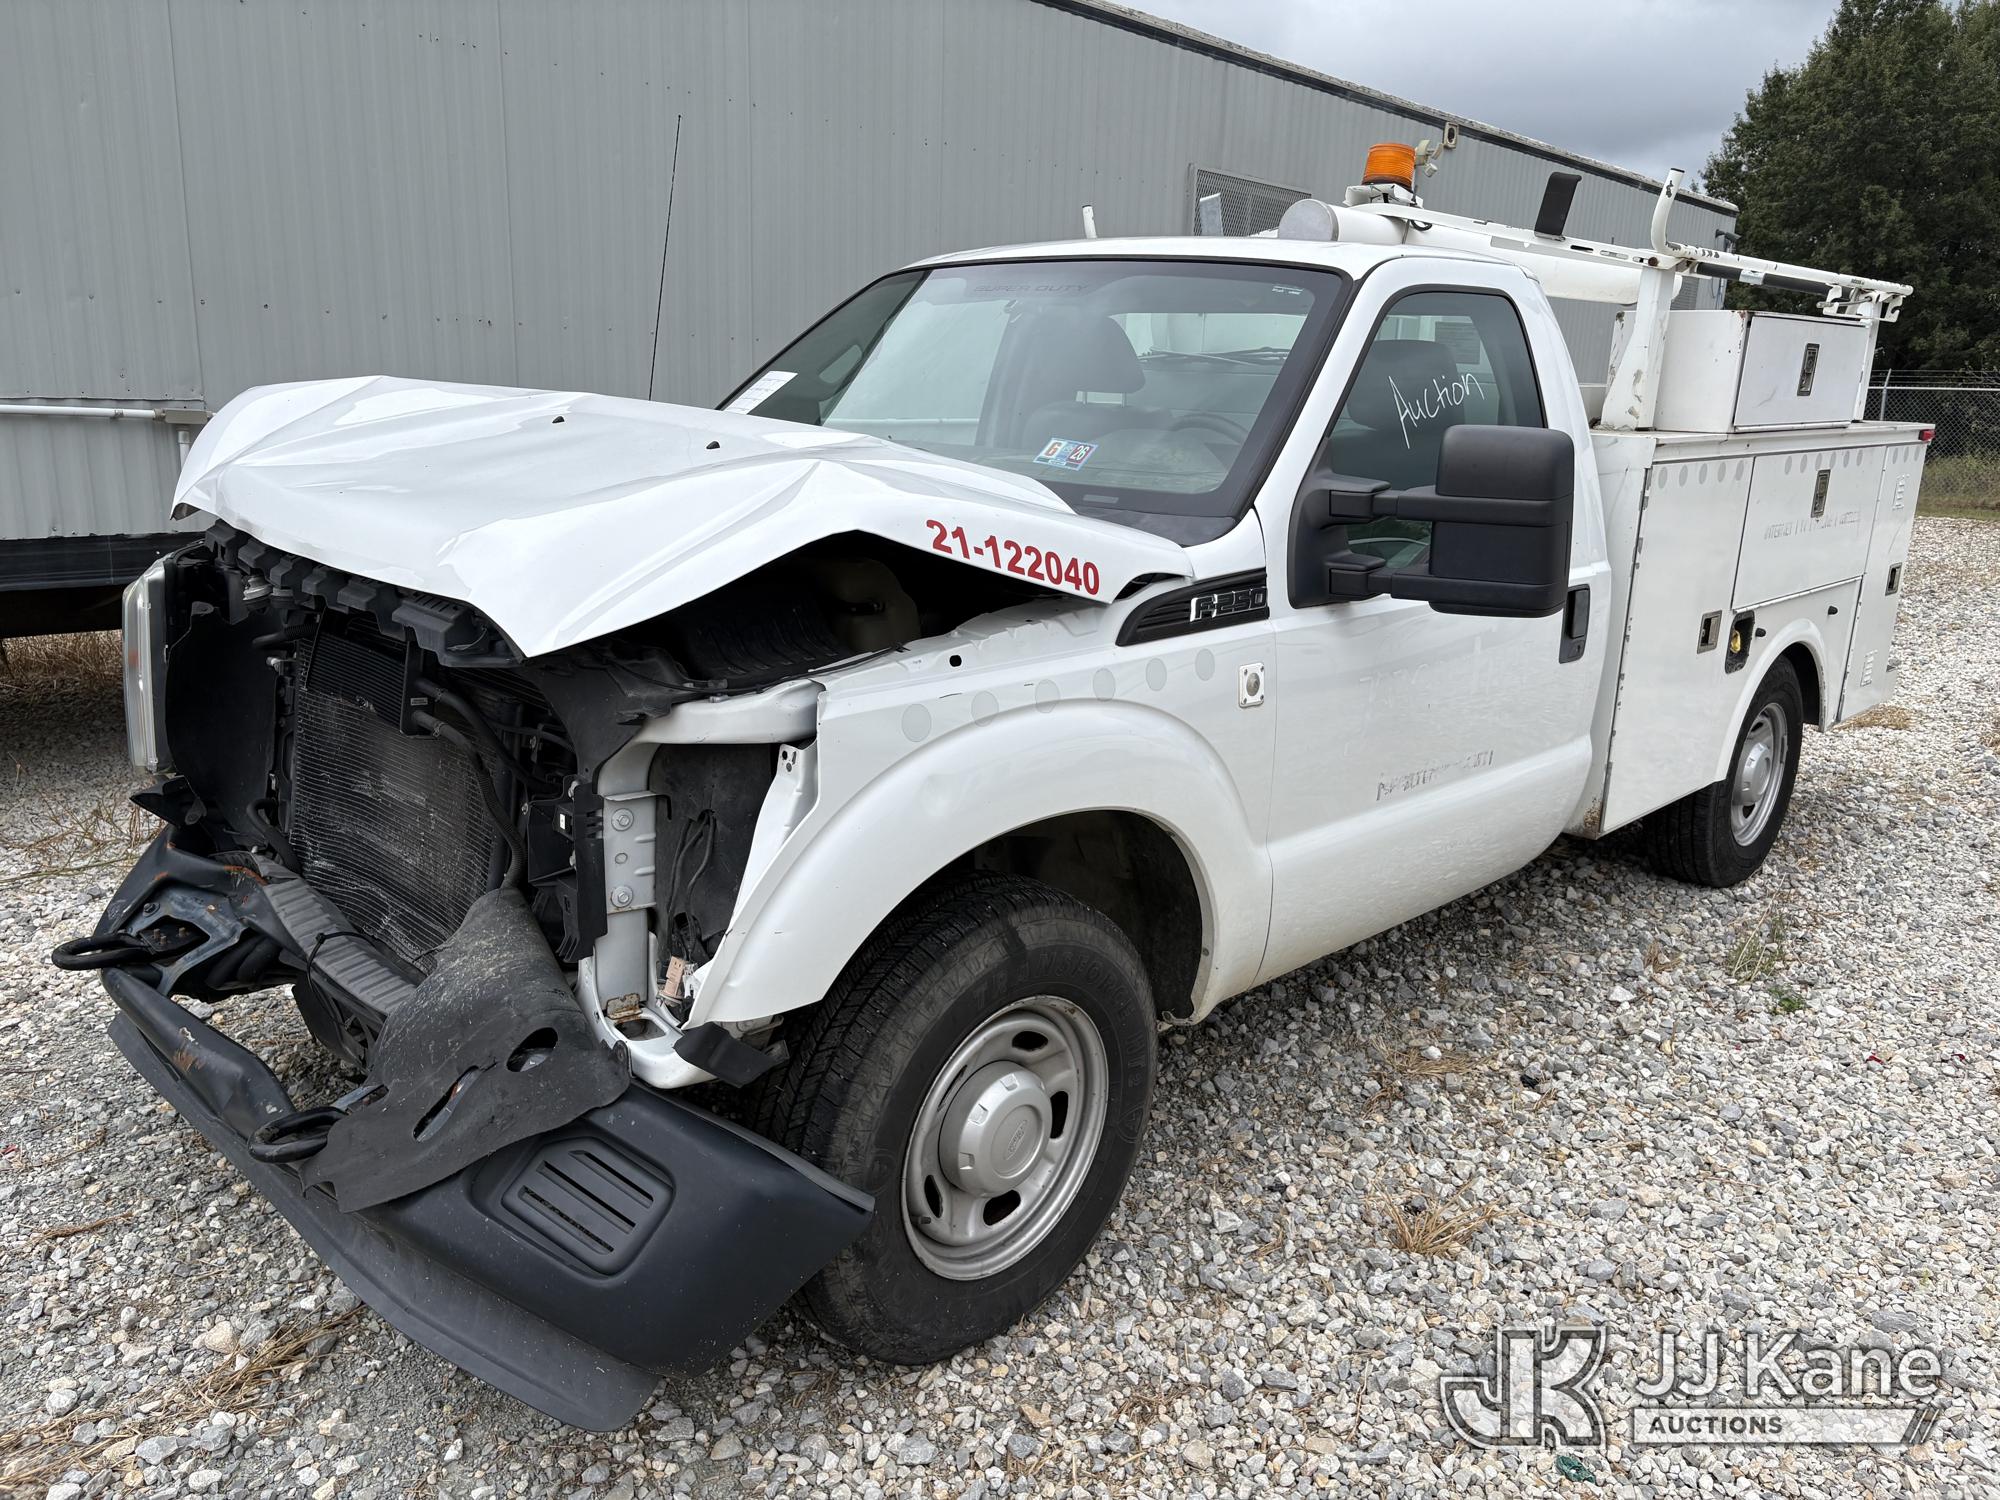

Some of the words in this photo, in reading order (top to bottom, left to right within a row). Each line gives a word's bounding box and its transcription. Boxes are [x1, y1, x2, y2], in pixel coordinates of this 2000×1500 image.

[1389, 374, 1485, 450] Auction
[1069, 445, 1090, 461] 26
[926, 519, 1100, 596] 21-122040
[1190, 587, 1266, 622] F-250
